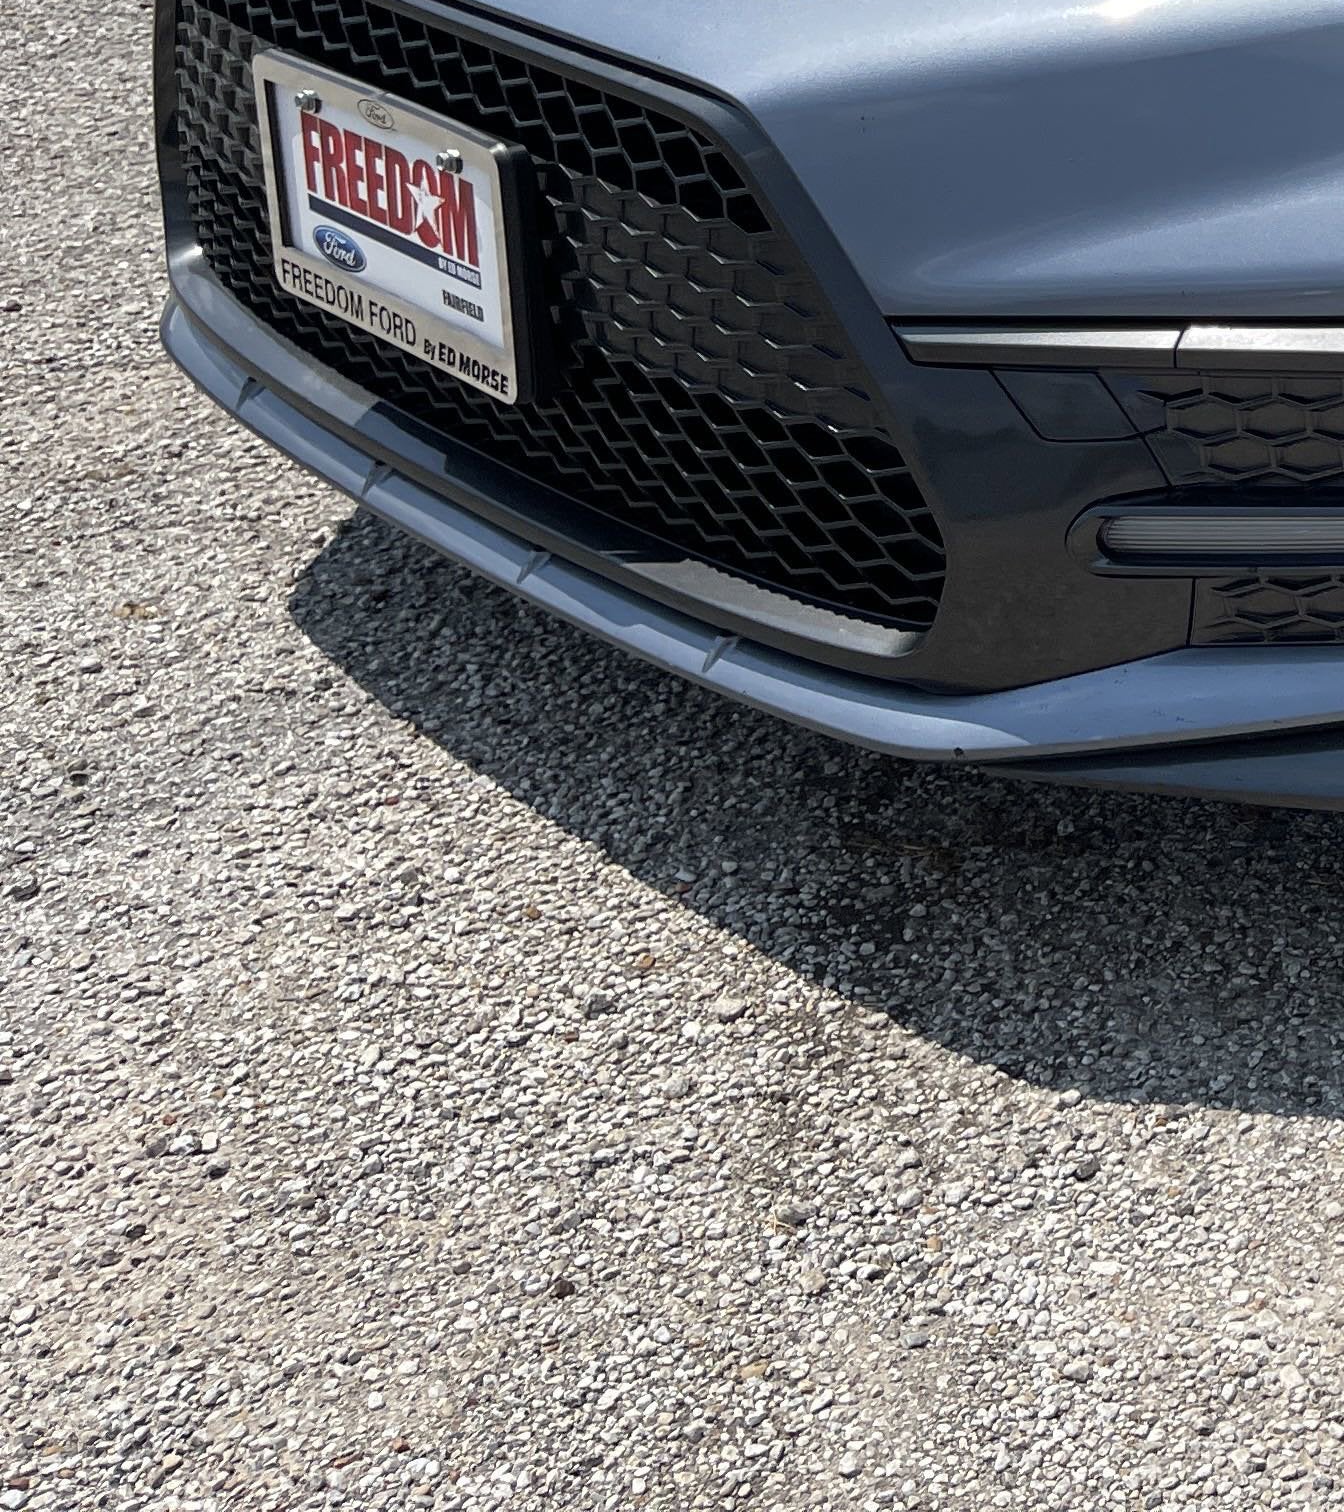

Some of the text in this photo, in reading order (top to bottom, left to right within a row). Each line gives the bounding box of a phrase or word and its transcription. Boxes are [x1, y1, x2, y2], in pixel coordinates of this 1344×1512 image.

[301, 110, 480, 268] FREEDOM
[322, 231, 357, 266] Ford
[281, 258, 365, 322] FREEDOM
[369, 298, 417, 347] FORD
[438, 342, 456, 368] ED
[458, 352, 509, 396] MORSE
[442, 289, 484, 322] FAIRFIELD
